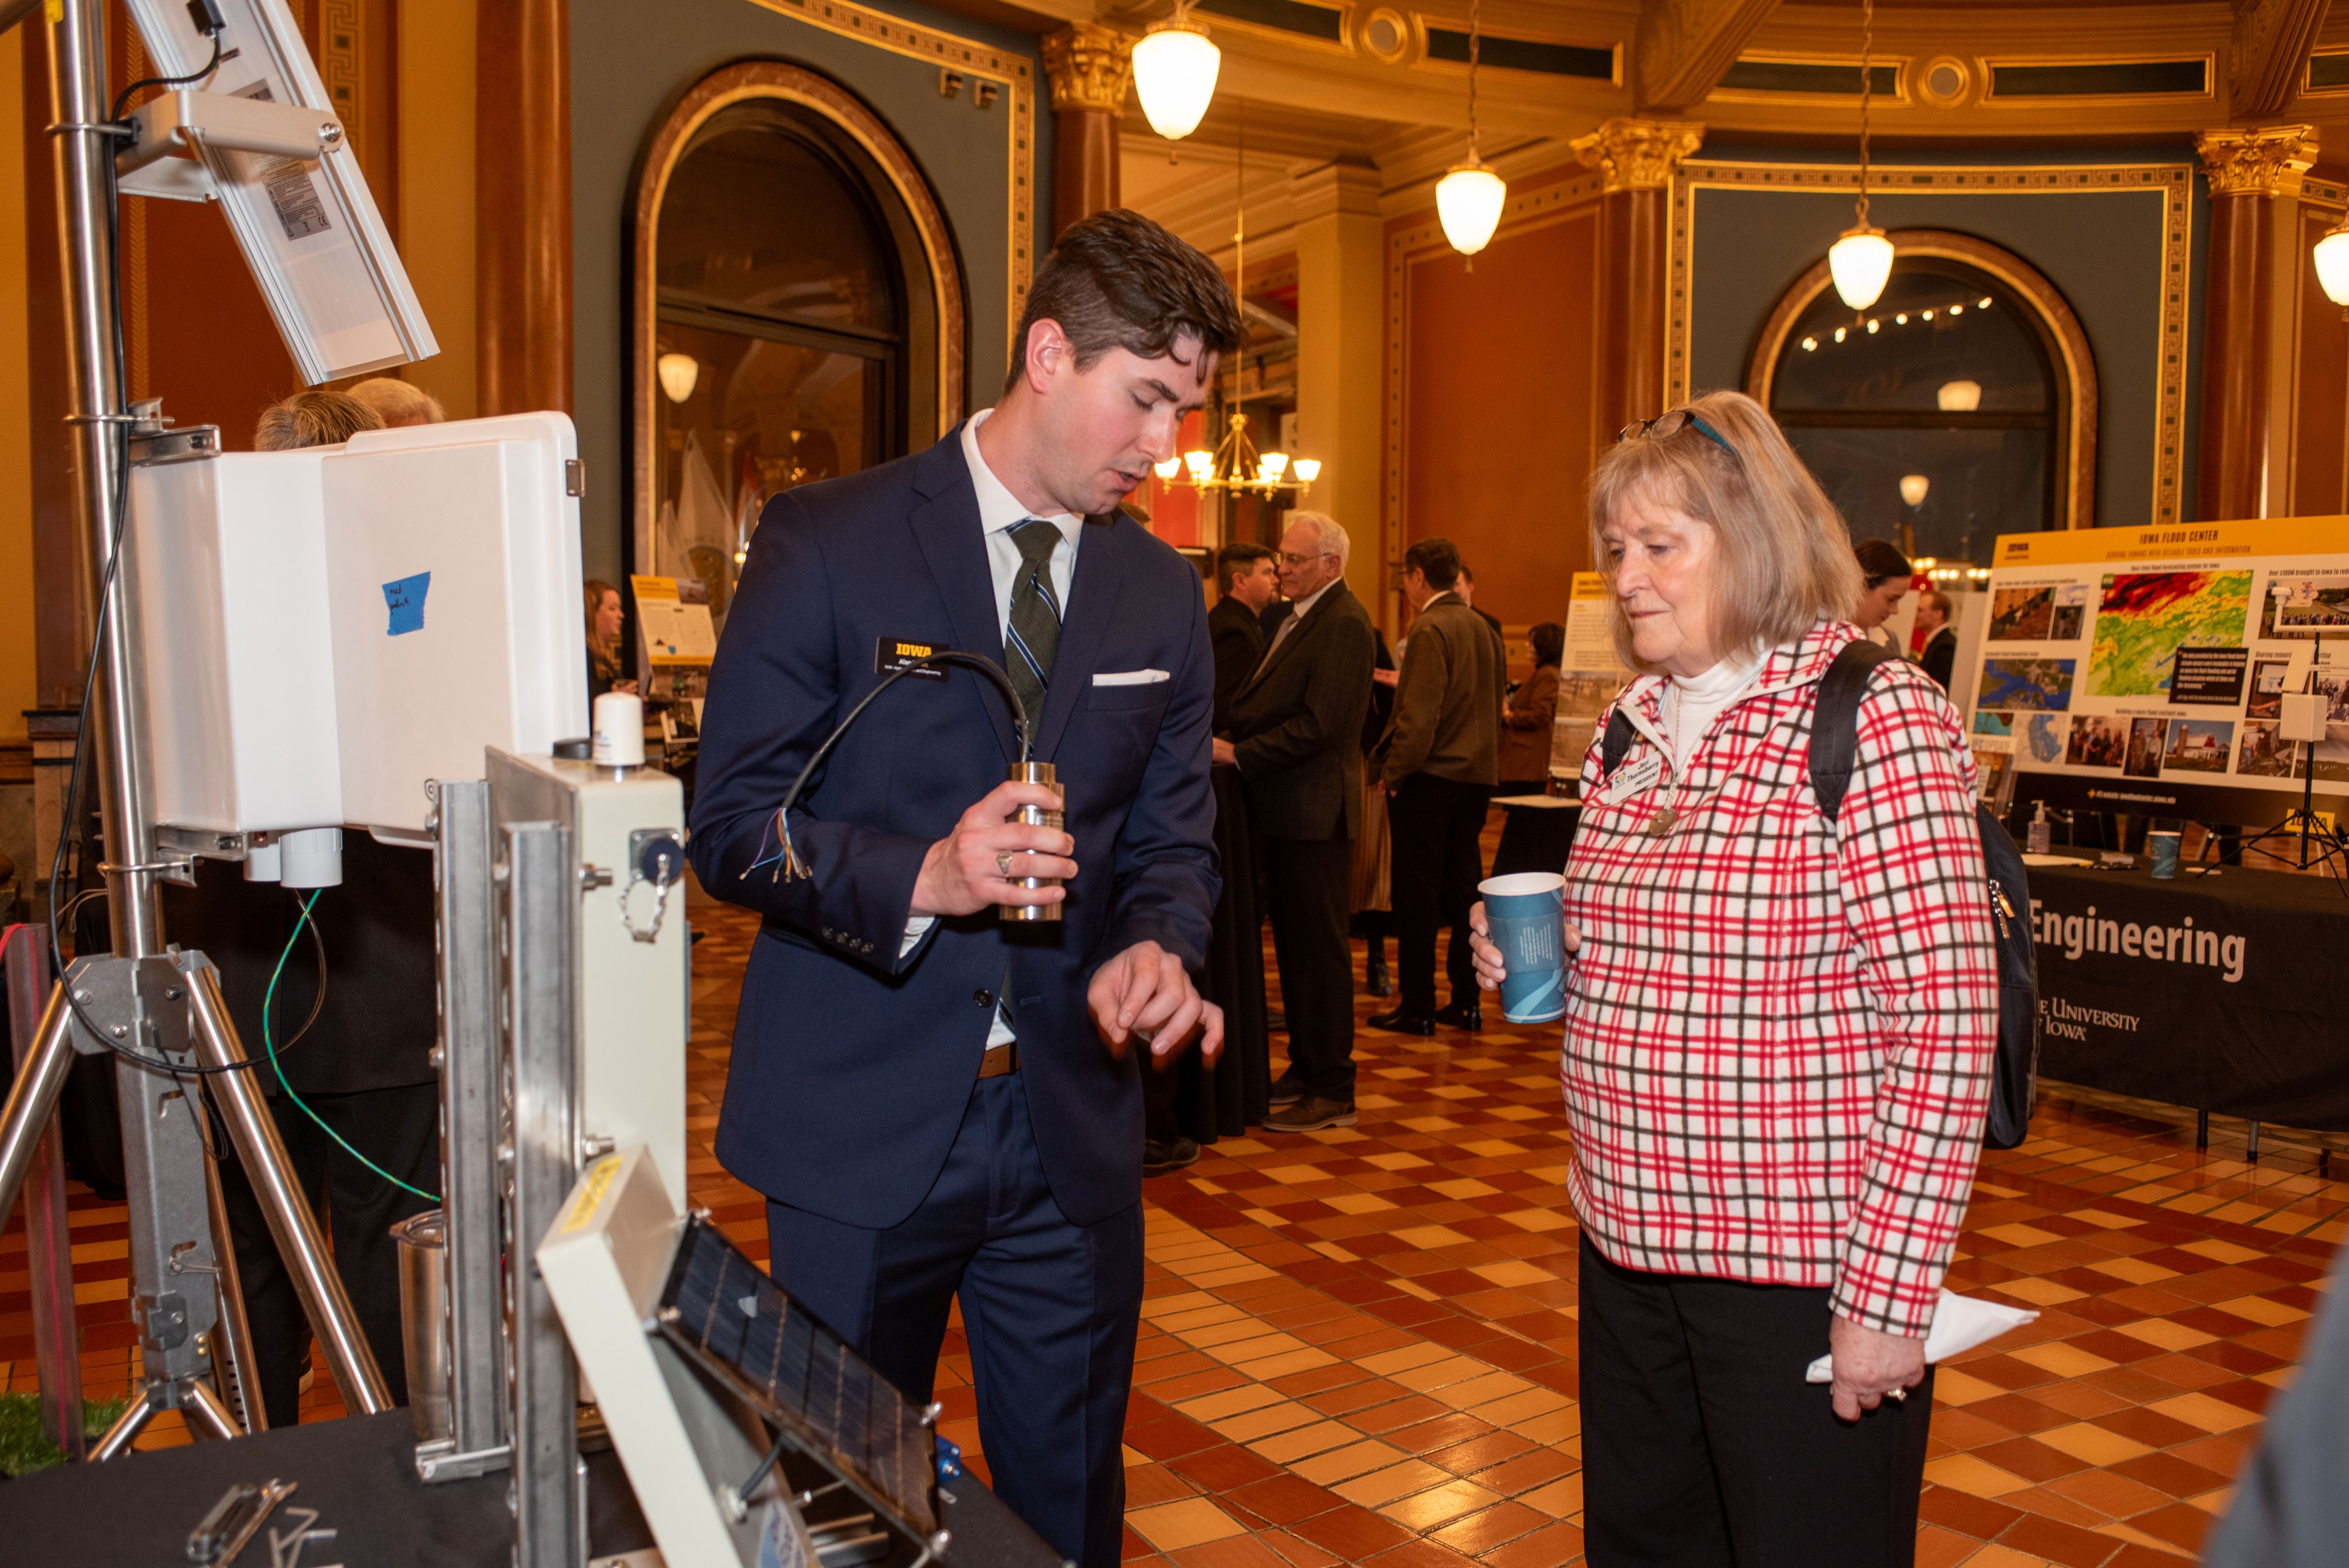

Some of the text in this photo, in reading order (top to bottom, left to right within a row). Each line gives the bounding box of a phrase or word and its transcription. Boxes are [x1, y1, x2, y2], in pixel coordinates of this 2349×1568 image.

[2140, 530, 2219, 544] IOWA FLOOD CENTER
[2149, 549, 2161, 557] WITH
[2187, 547, 2201, 556] TOOLS
[2203, 547, 2214, 555] AND
[2215, 545, 2251, 554] INFORMATION
[896, 643, 932, 657] IOWA
[1627, 761, 1659, 782] Thornsberry
[1638, 759, 1649, 770] Jeri
[1635, 770, 1658, 787] PRESIDENT
[2029, 899, 2246, 983] Engineering
[2052, 997, 2140, 1032] UNIVERSITY
[2045, 1016, 2087, 1041] IOWA
